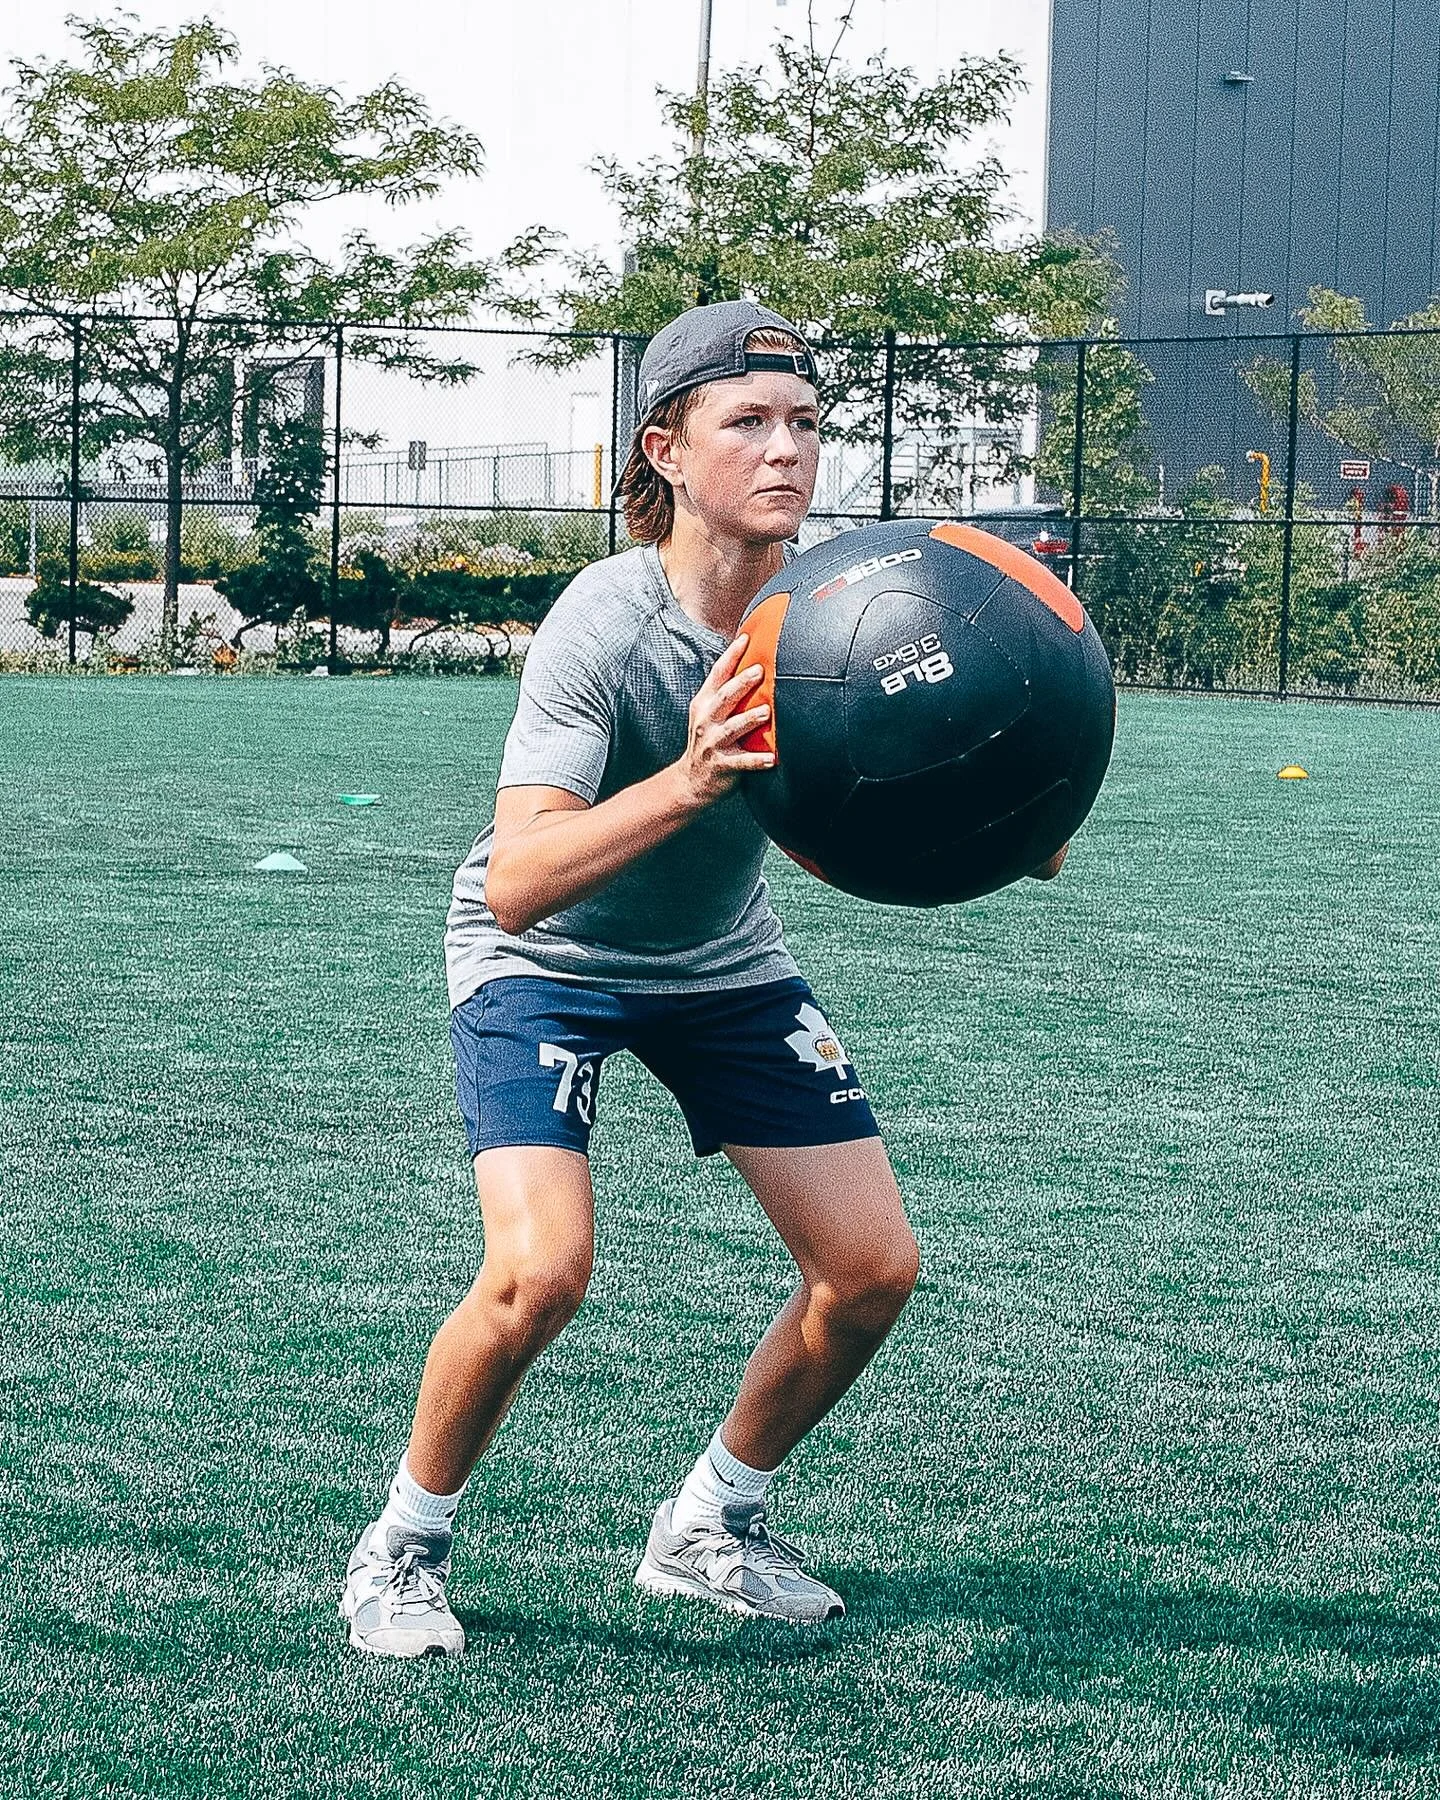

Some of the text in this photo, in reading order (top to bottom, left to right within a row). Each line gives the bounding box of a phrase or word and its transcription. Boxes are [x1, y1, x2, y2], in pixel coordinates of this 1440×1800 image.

[872, 633, 941, 671] 3.6KG
[880, 651, 954, 695] 8LB
[538, 1042, 594, 1125] 73
